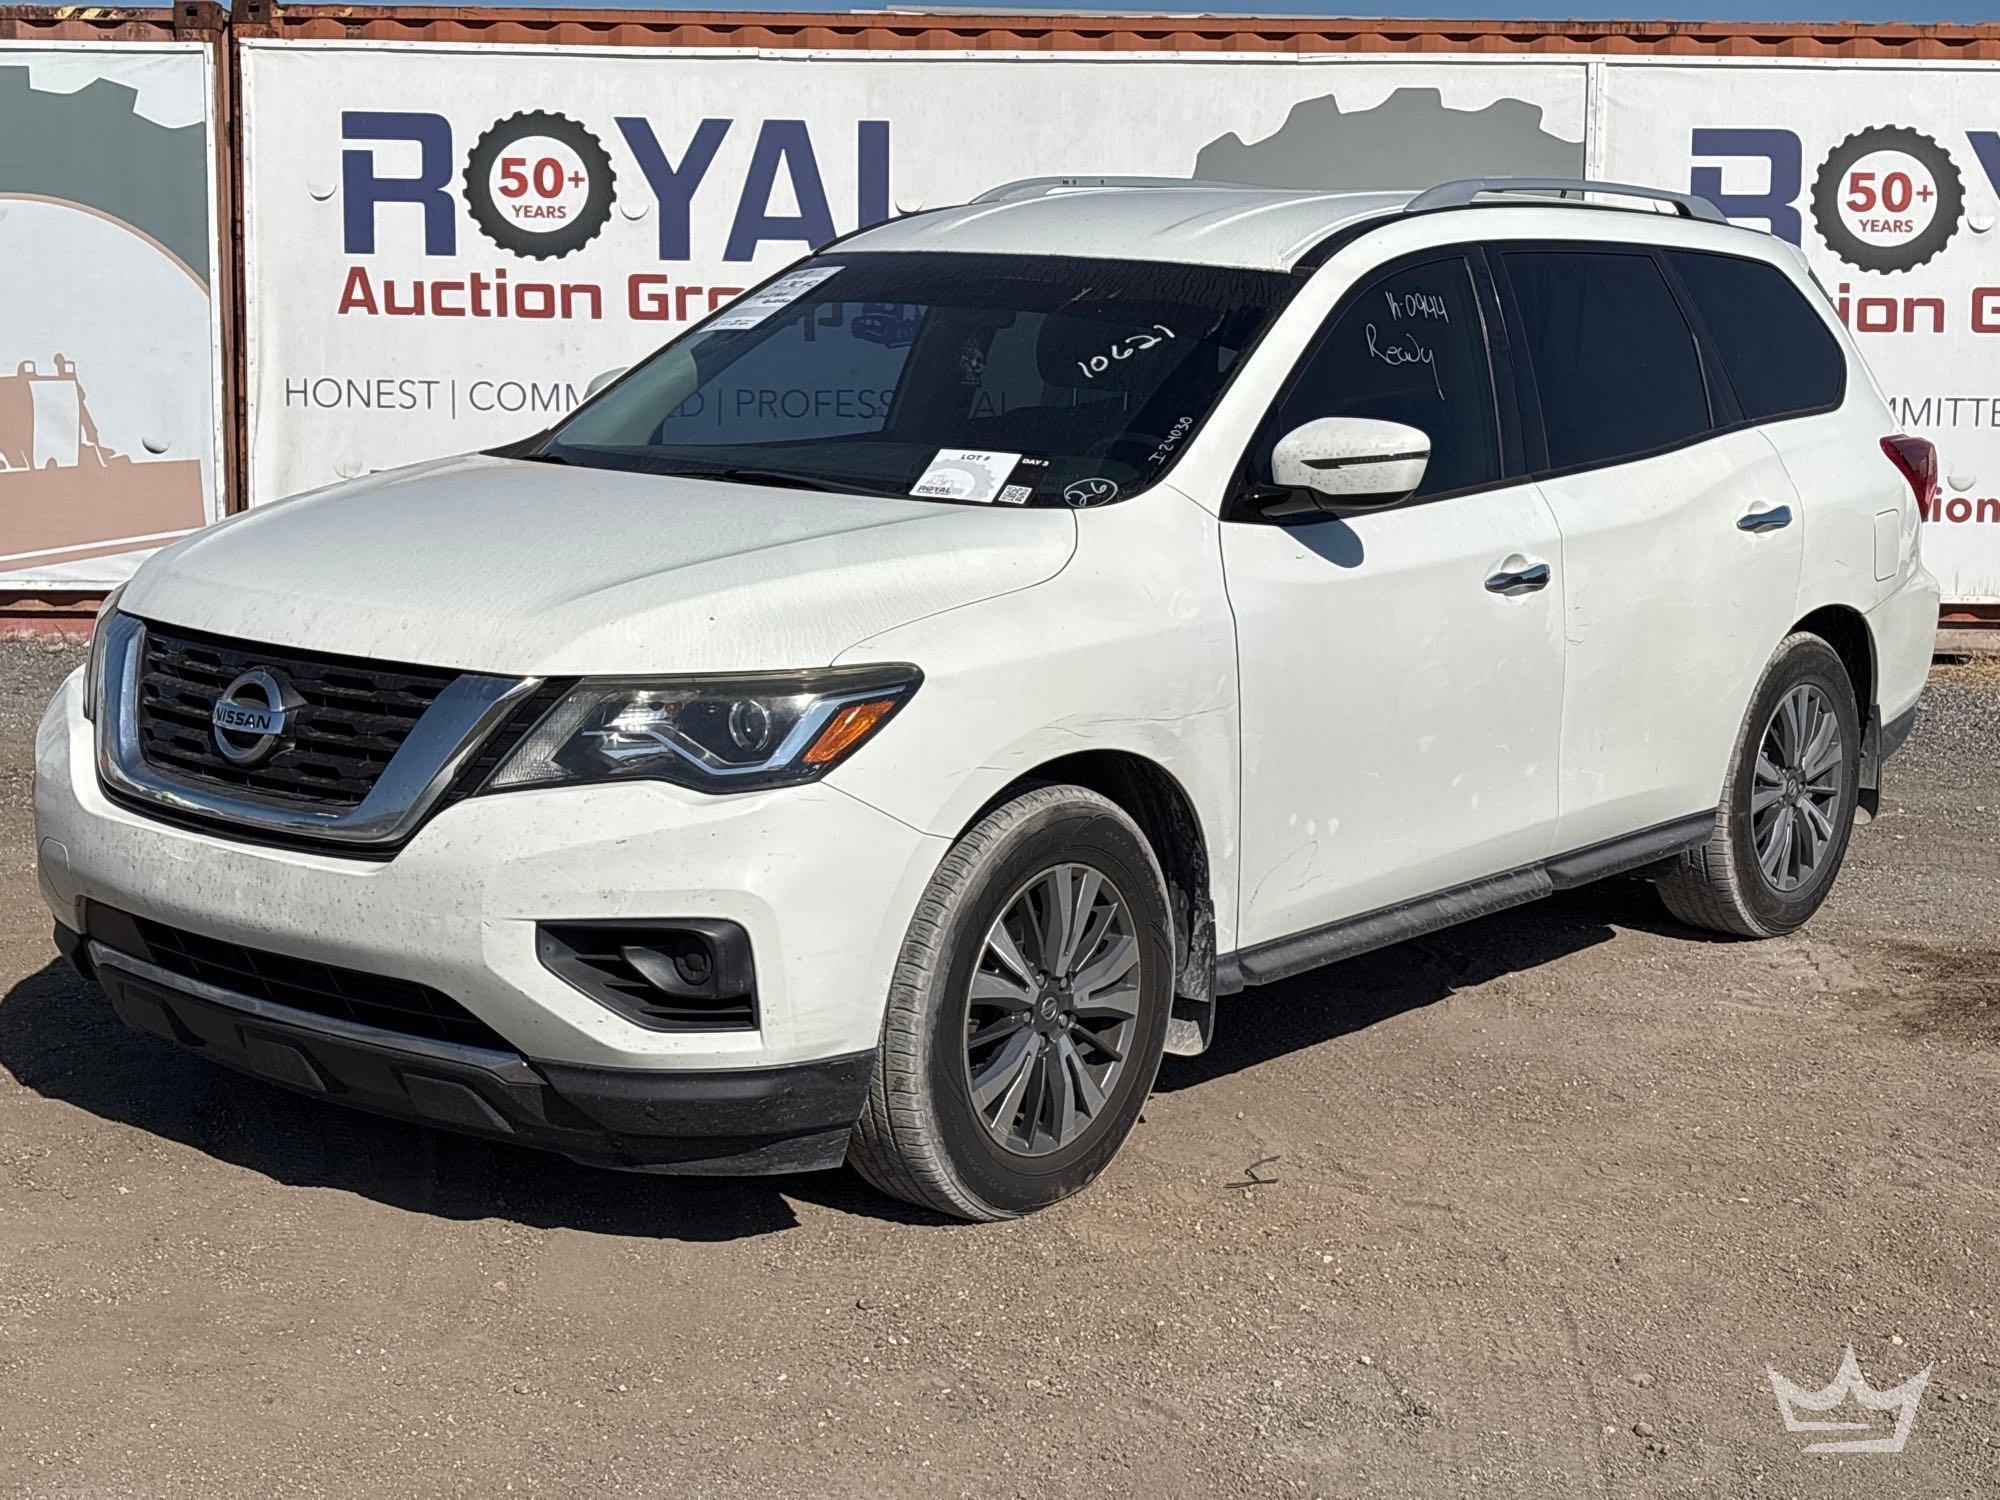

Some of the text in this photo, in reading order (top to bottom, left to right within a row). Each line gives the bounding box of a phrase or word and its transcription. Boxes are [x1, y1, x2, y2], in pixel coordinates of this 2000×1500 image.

[498, 157, 586, 199] 50+
[1847, 172, 1934, 213] 50+
[512, 205, 567, 219] YEARS
[1859, 219, 1913, 233] YEARS
[338, 266, 602, 320] Auction
[1077, 325, 1175, 378] 10621
[286, 378, 440, 410] HONEST
[216, 707, 271, 729] NISSAN
